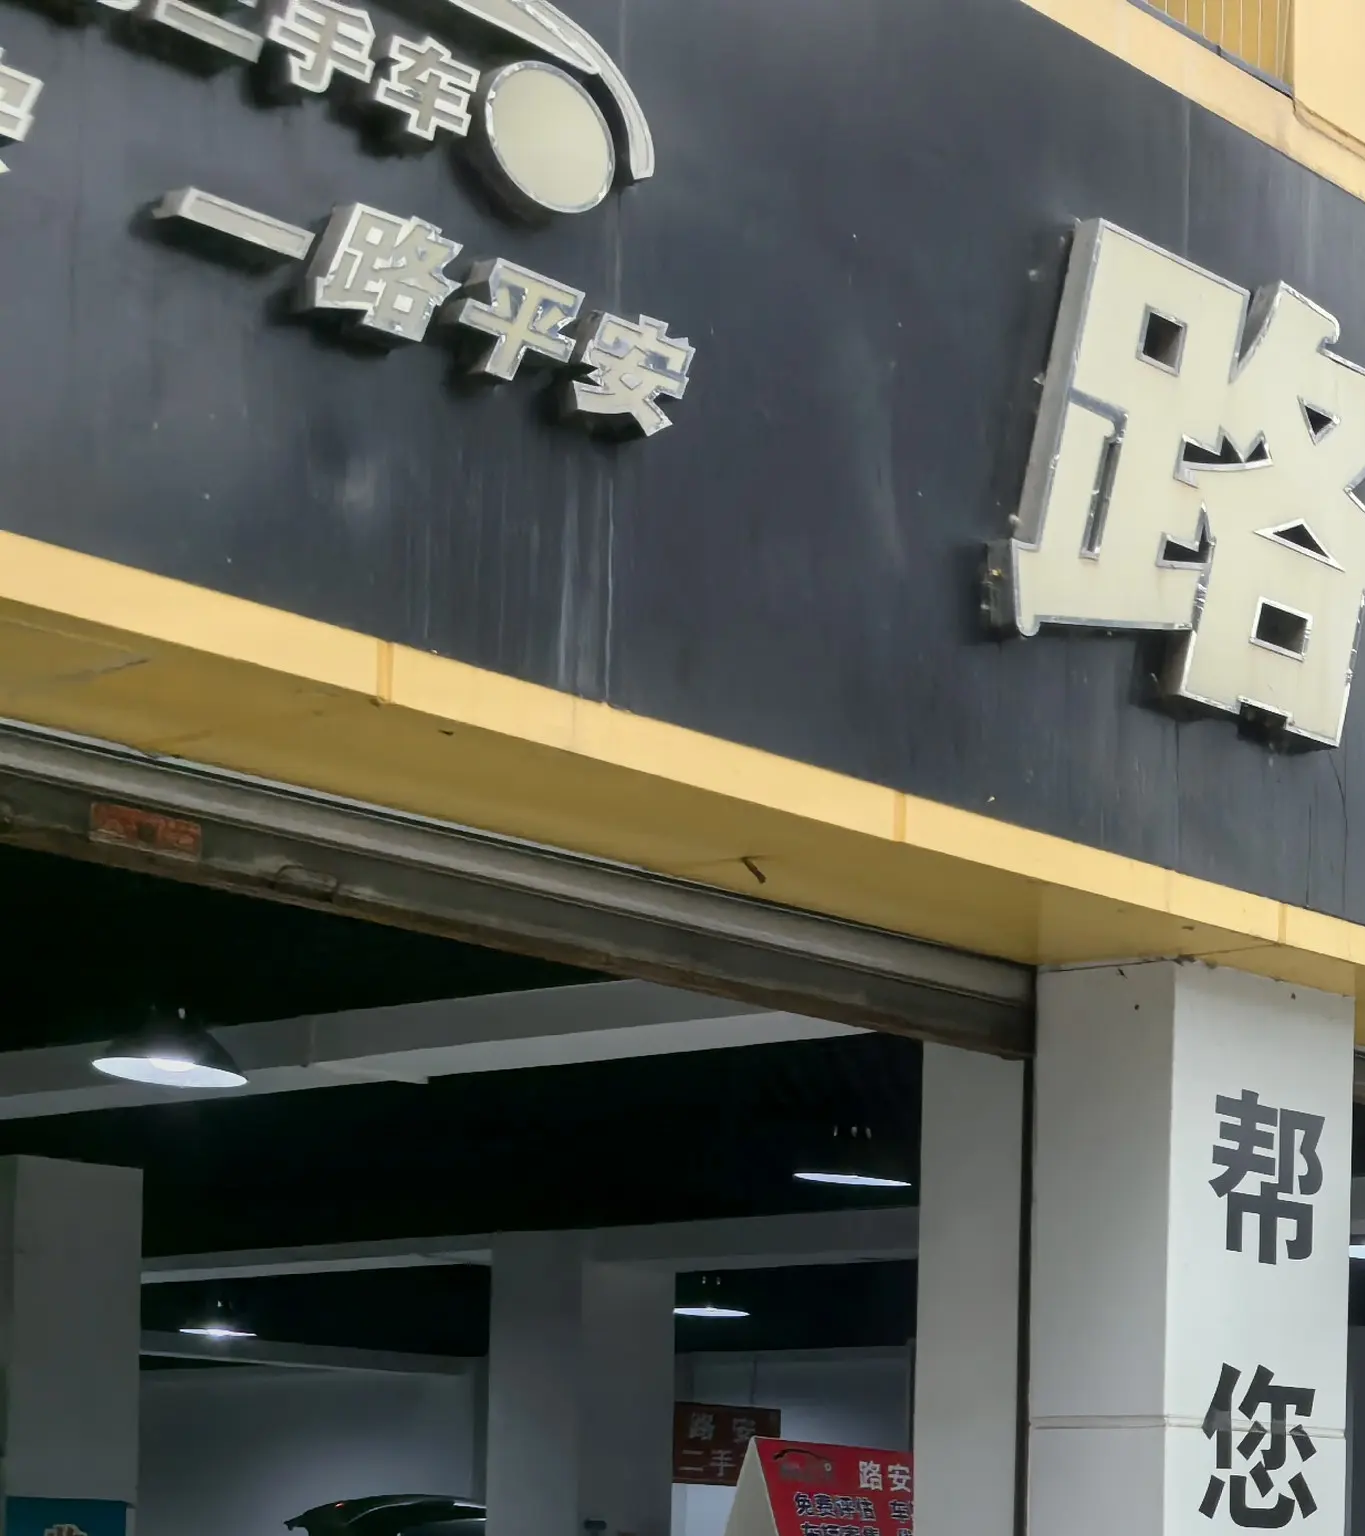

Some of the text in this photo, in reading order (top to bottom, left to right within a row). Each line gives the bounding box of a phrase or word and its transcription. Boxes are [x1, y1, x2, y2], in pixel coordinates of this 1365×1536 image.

[97, 0, 480, 140] 二手车
[158, 186, 696, 436] 一路平安
[678, 1449, 745, 1477] 二手
[889, 1499, 913, 1524] 车
